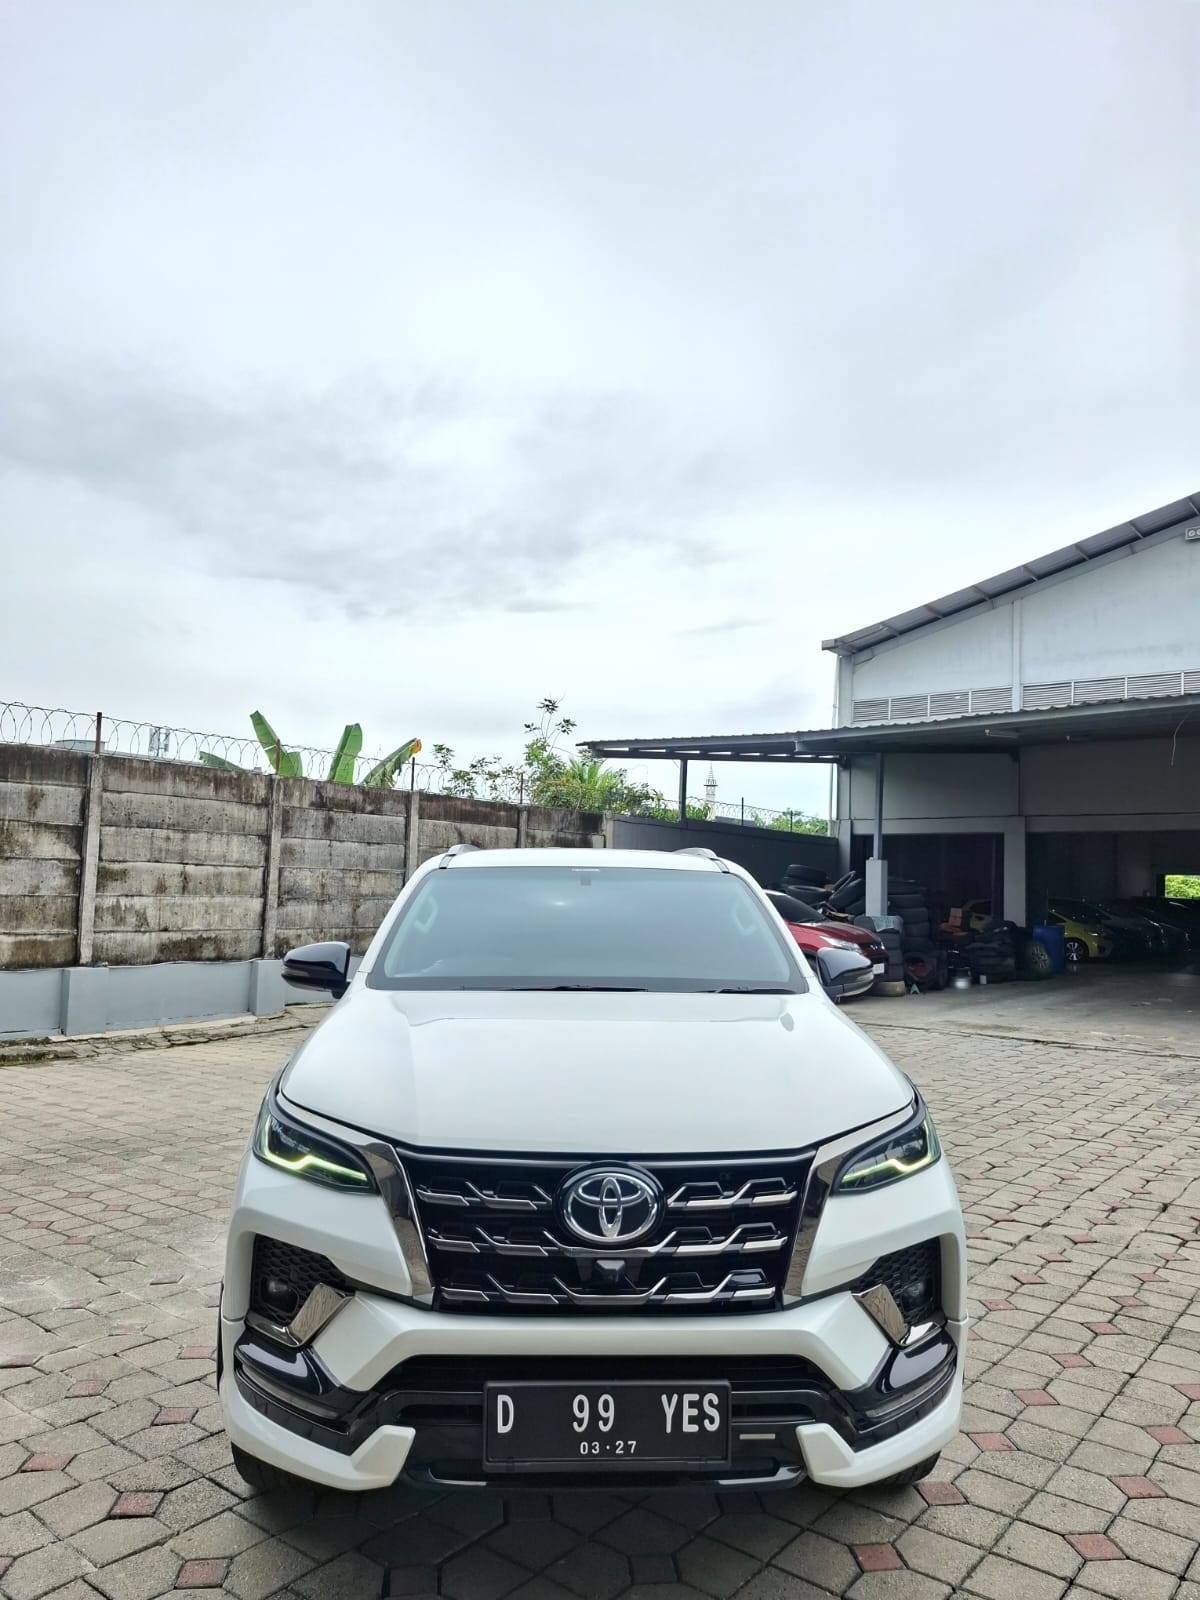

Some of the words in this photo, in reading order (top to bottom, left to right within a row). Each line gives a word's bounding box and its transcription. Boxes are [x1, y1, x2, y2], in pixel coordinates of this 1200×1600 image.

[496, 1393, 515, 1434] D
[572, 1393, 615, 1433] 99
[660, 1392, 721, 1434] YES
